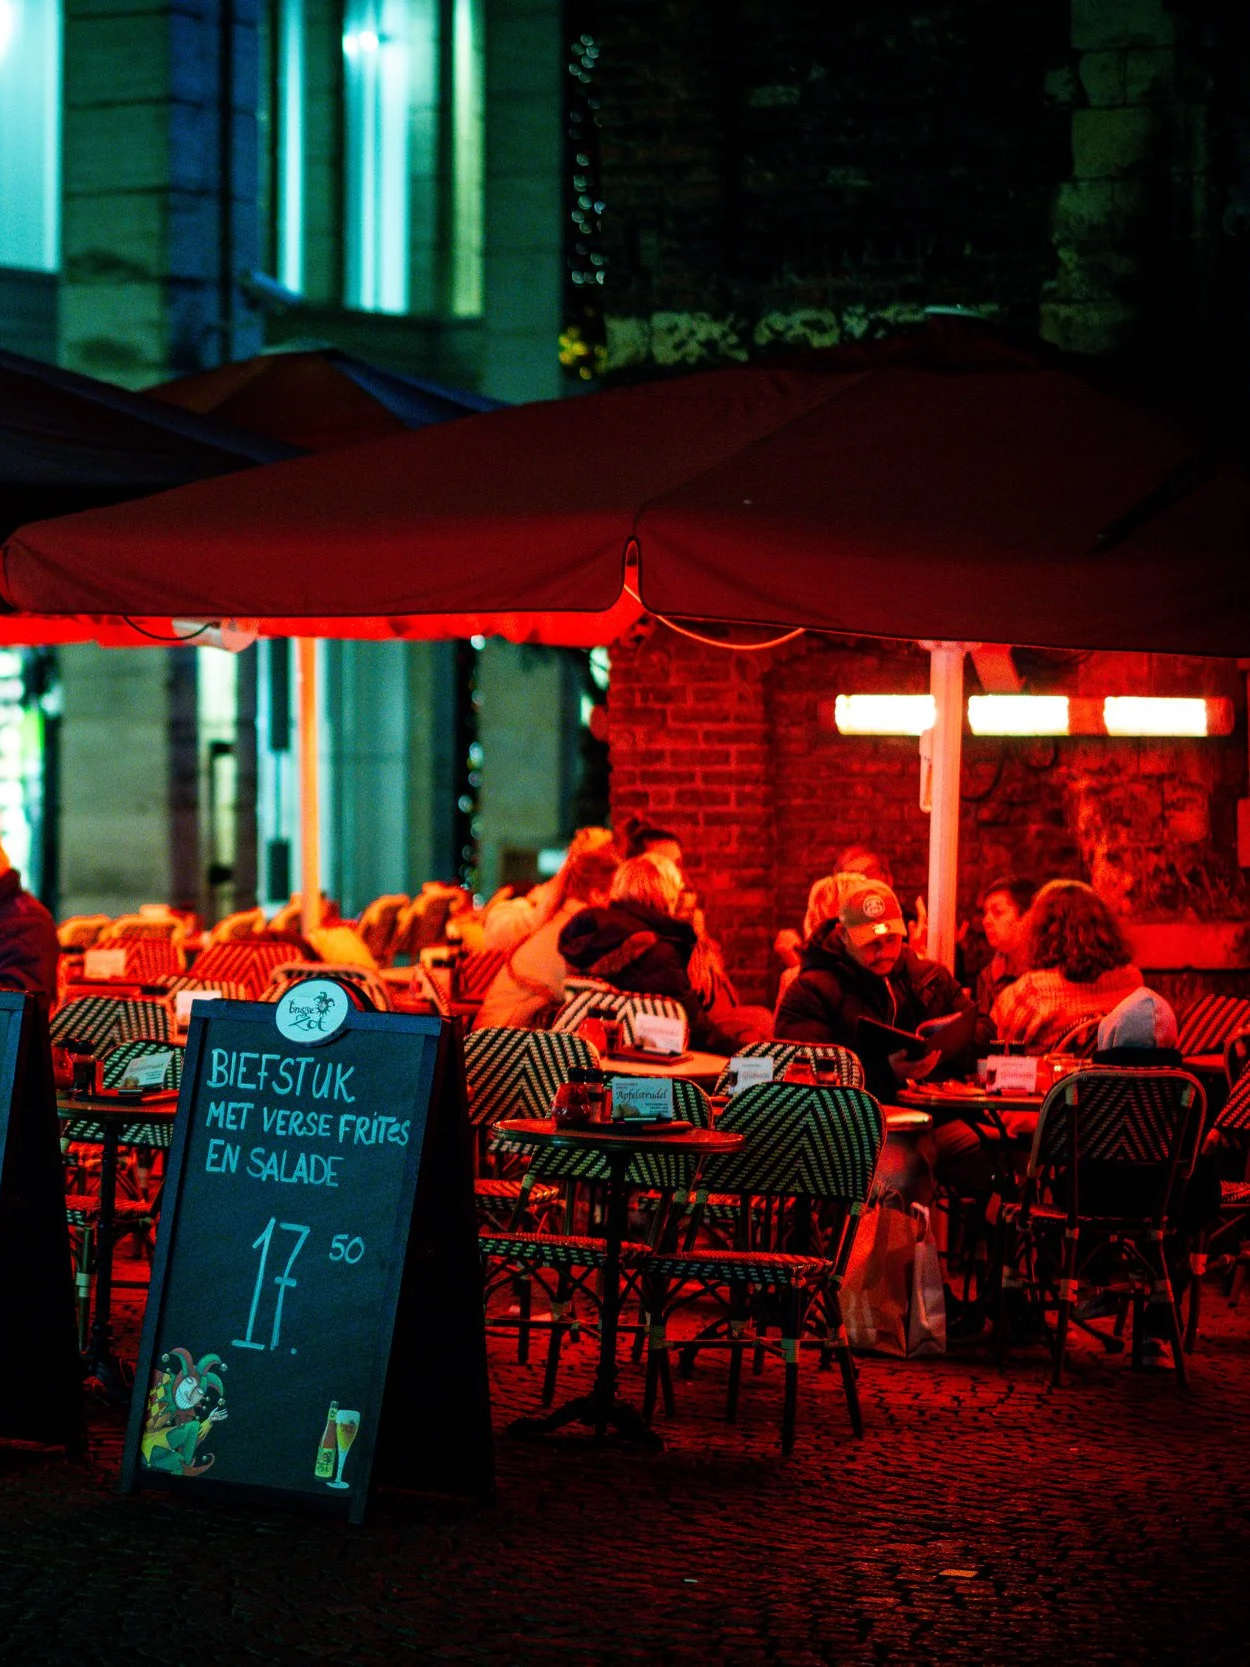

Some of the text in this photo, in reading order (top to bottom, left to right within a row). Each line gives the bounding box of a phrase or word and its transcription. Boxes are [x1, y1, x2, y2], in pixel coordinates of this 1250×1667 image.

[288, 1014, 330, 1032] Zot
[206, 1048, 356, 1103] BIEFSTUK
[616, 1088, 668, 1102] Apfelstrudel
[205, 1100, 255, 1132] MET
[262, 1106, 331, 1138] VERSE
[205, 1139, 344, 1188] EN SALADE
[328, 1234, 365, 1264] 50
